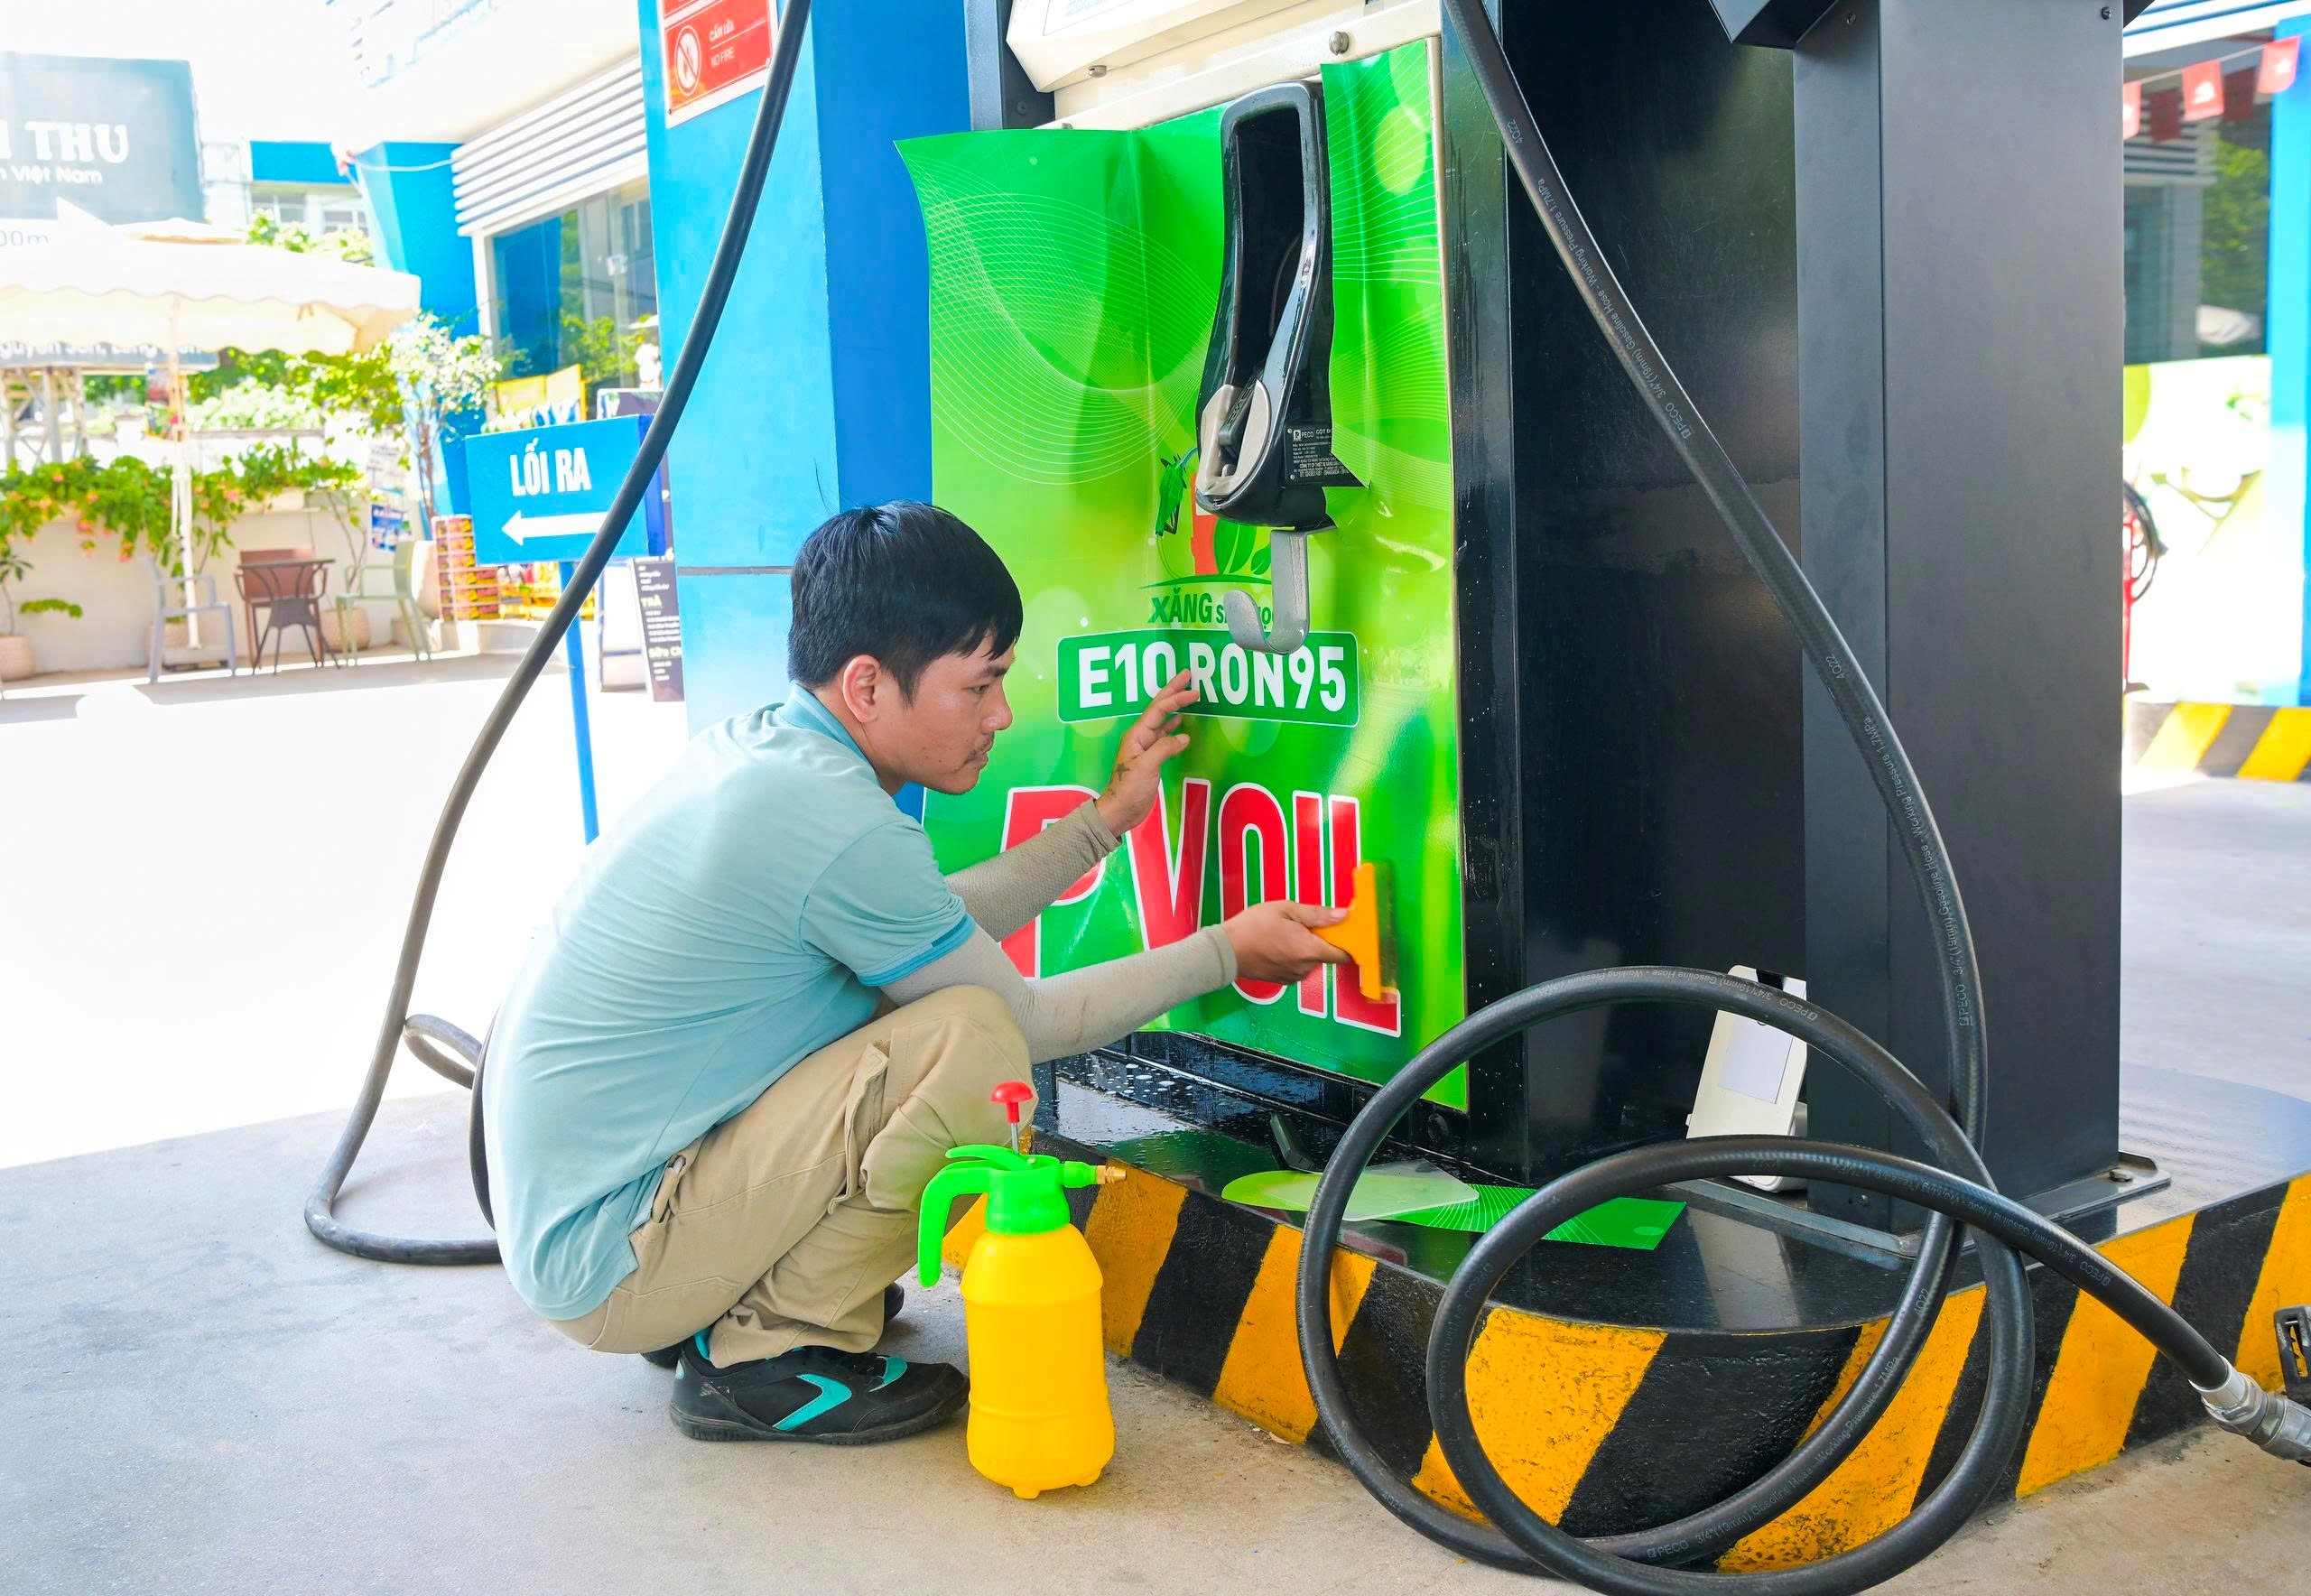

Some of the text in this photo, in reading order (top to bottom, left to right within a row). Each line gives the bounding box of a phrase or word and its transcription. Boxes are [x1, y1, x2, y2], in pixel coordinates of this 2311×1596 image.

[711, 46, 735, 68] NO FIRE
[24, 121, 129, 163] THU
[1507, 119, 1524, 144] 4Q22
[56, 166, 103, 183] Nam
[1538, 179, 1558, 212] 1.7MPa
[1555, 211, 1578, 251] Pressure
[1576, 248, 1598, 287] Working
[1598, 290, 1614, 314] Hose
[1610, 312, 1636, 350] Gasoline
[1665, 403, 1688, 433] PECO
[510, 437, 592, 496] LỐI RA
[1147, 587, 1213, 624] XĂNG
[1078, 641, 1347, 712] E10 RON95
[1825, 654, 1845, 679] 4Q22
[1863, 717, 1886, 753] 1.7MPa
[1882, 753, 1907, 798] Pressure
[1901, 793, 1923, 838] Working
[1921, 845, 1935, 870] Hose
[1930, 872, 1950, 915] Gasoline
[1607, 970, 1643, 979] Working
[1652, 970, 1675, 979] Hose
[1677, 970, 1718, 986] Gasoline
[1779, 998, 1808, 1017] PECO
[1955, 984, 1968, 1019] PECO
[1993, 1212, 2031, 1237] Gasoline
[2080, 1260, 2105, 1285] PECO
[1914, 1288, 1930, 1315] 4Q22
[1657, 1540, 1689, 1556] PECO
[1751, 1486, 1791, 1516] Gasoline
[1787, 1468, 1814, 1488] Hose
[1815, 1426, 1851, 1466] Working
[1845, 1394, 1879, 1431] Pressure
